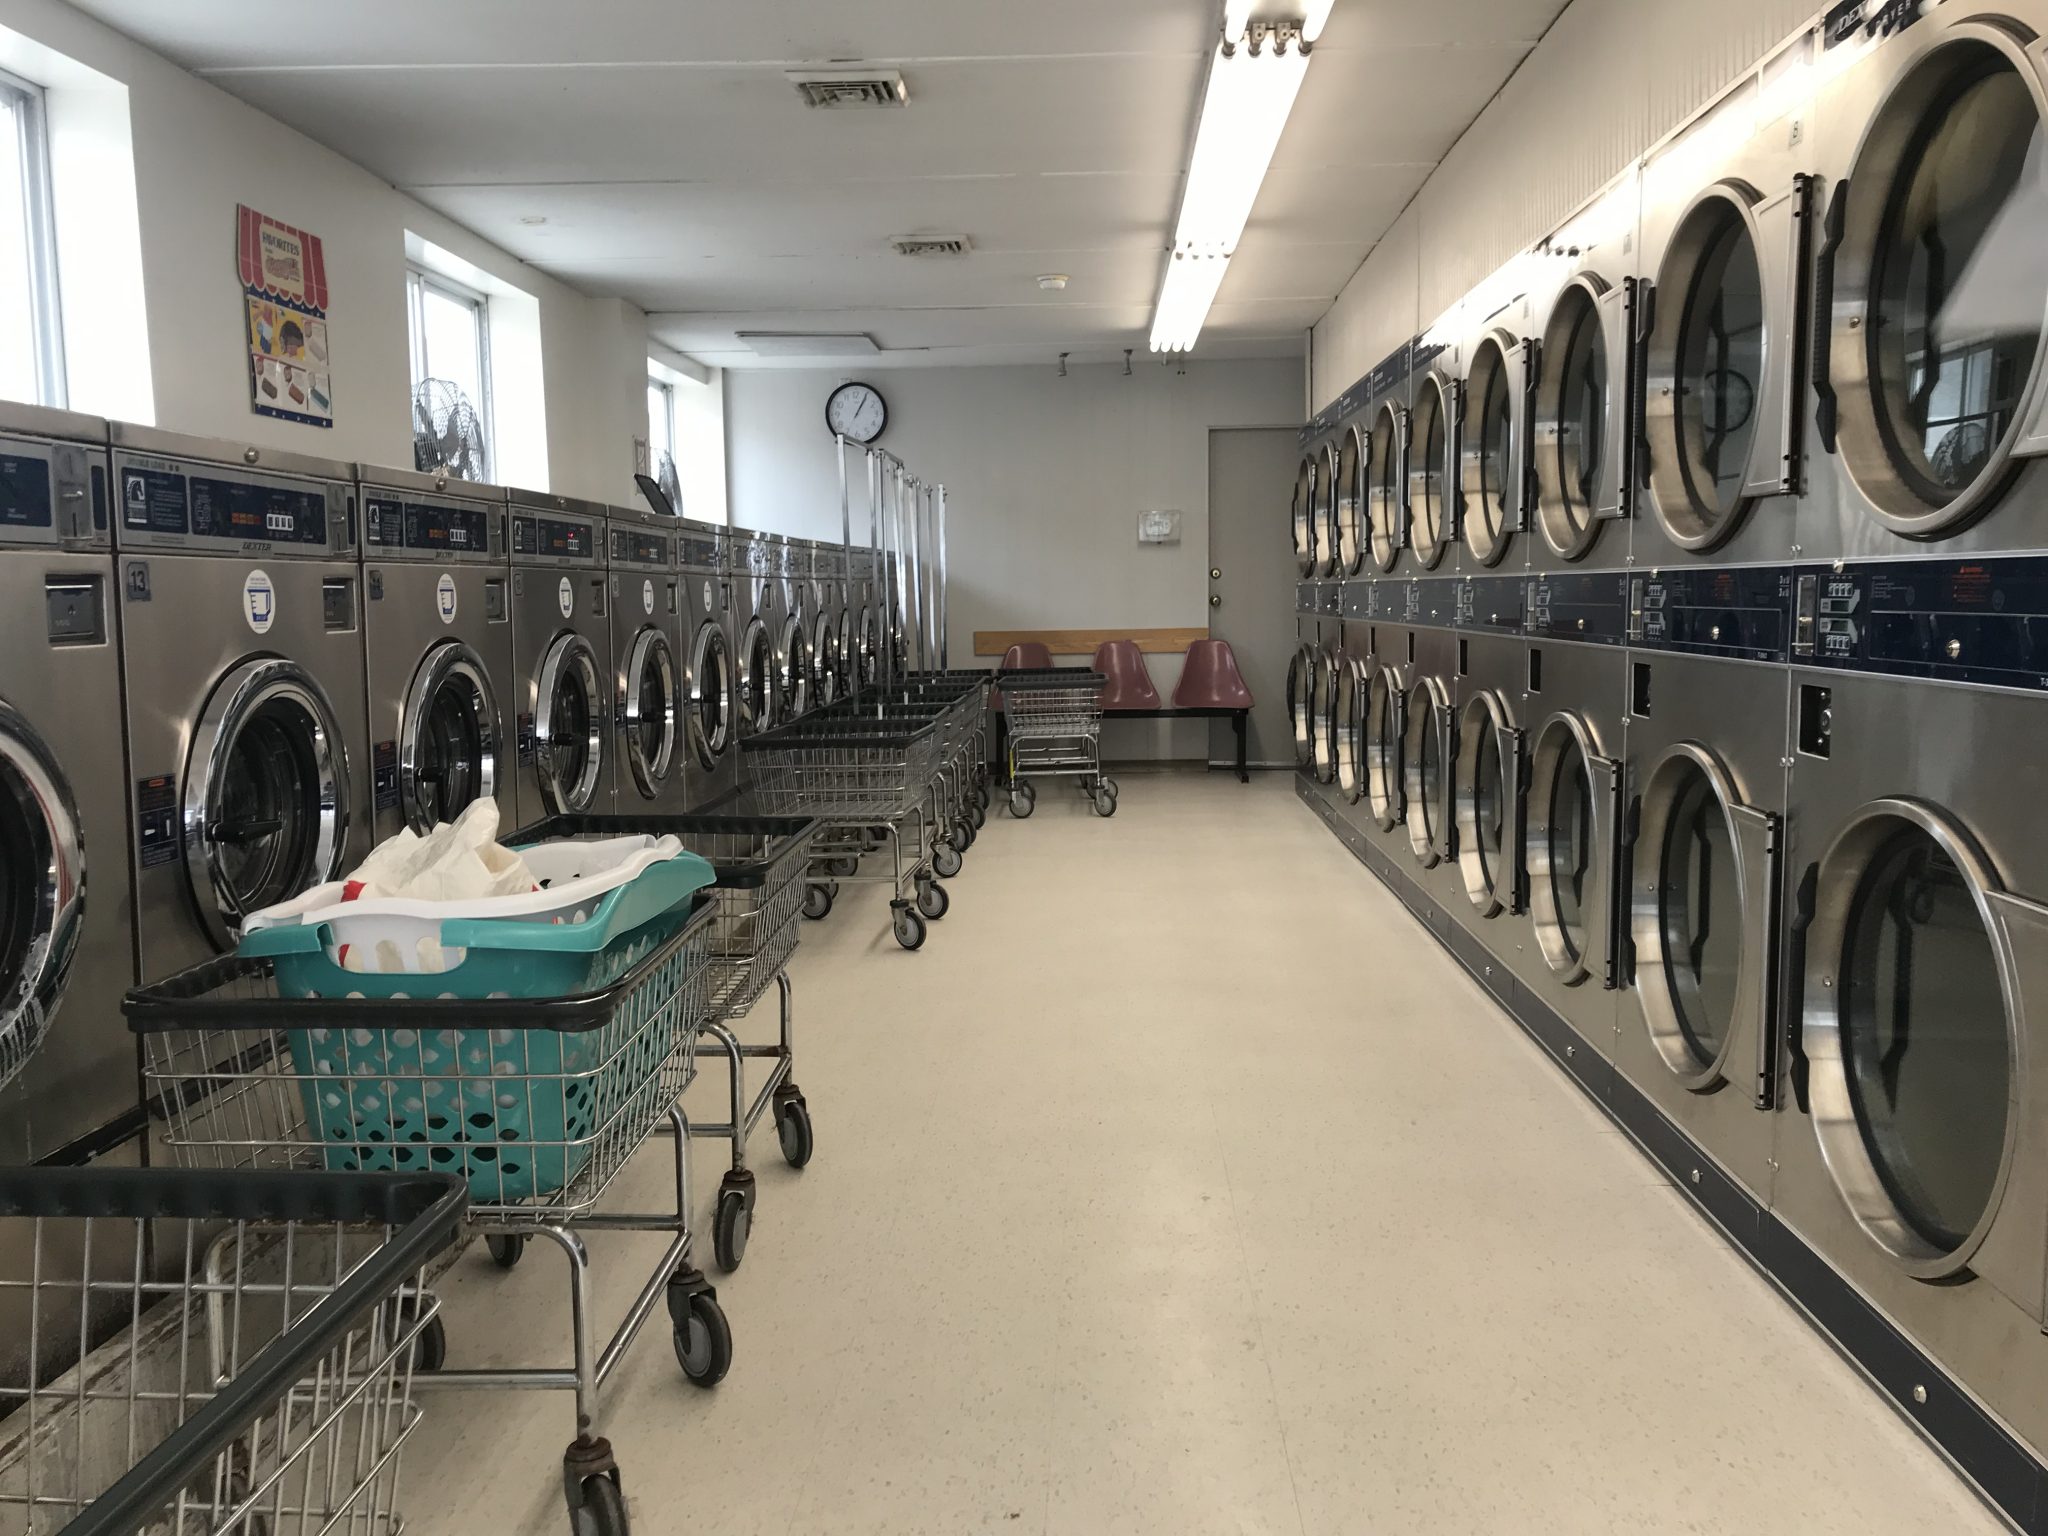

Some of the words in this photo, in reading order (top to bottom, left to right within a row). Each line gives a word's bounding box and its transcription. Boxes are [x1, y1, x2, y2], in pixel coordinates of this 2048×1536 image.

[262, 232, 299, 256] FAVORITES
[241, 541, 272, 551] DEXTER
[131, 570, 146, 592] 13
